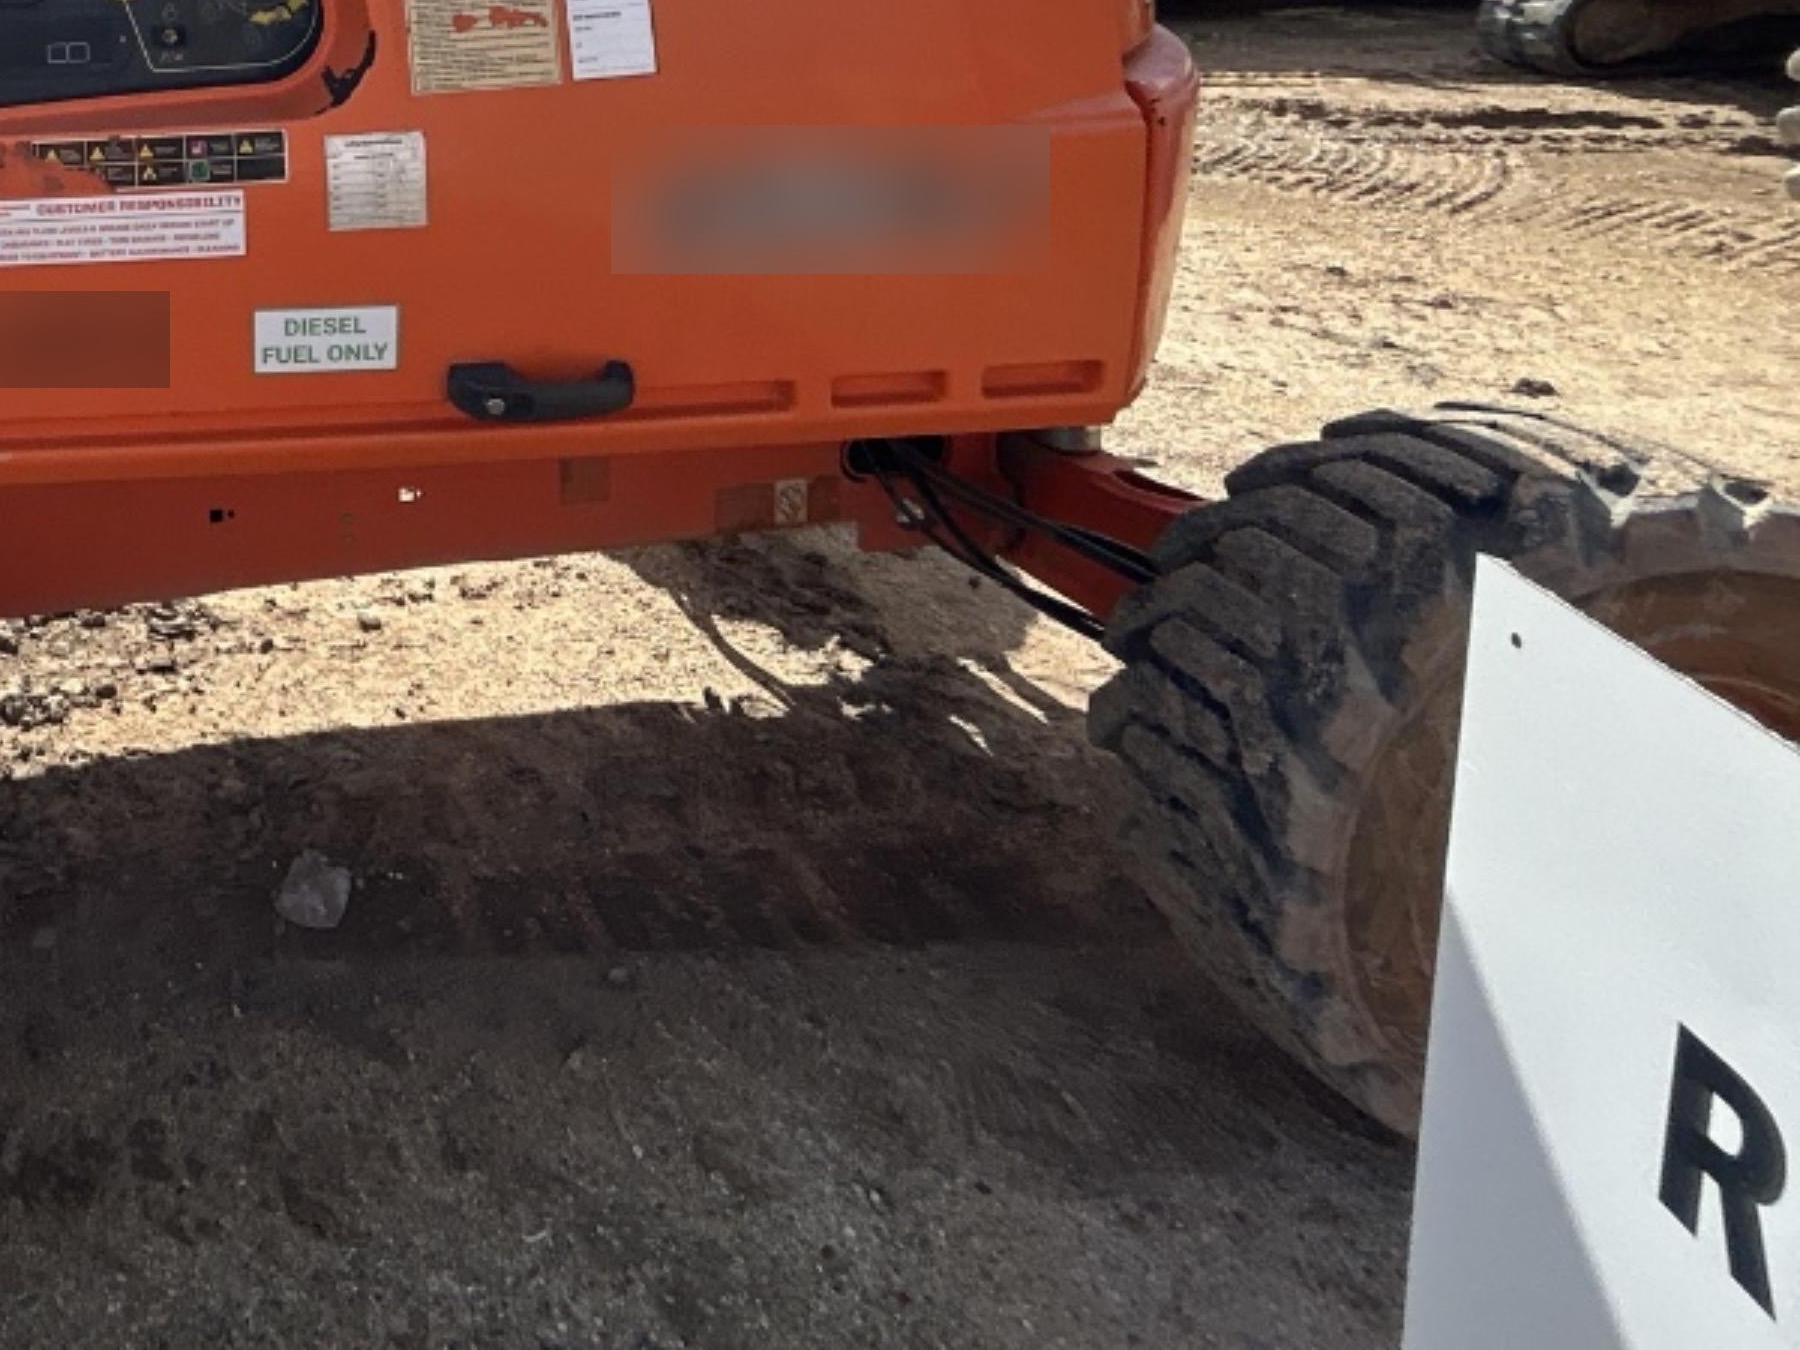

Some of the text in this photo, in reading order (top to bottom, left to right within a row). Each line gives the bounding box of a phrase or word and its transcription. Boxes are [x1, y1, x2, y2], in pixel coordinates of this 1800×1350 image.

[284, 316, 367, 338] DIESEL
[262, 342, 389, 365] FUEL ONLY
